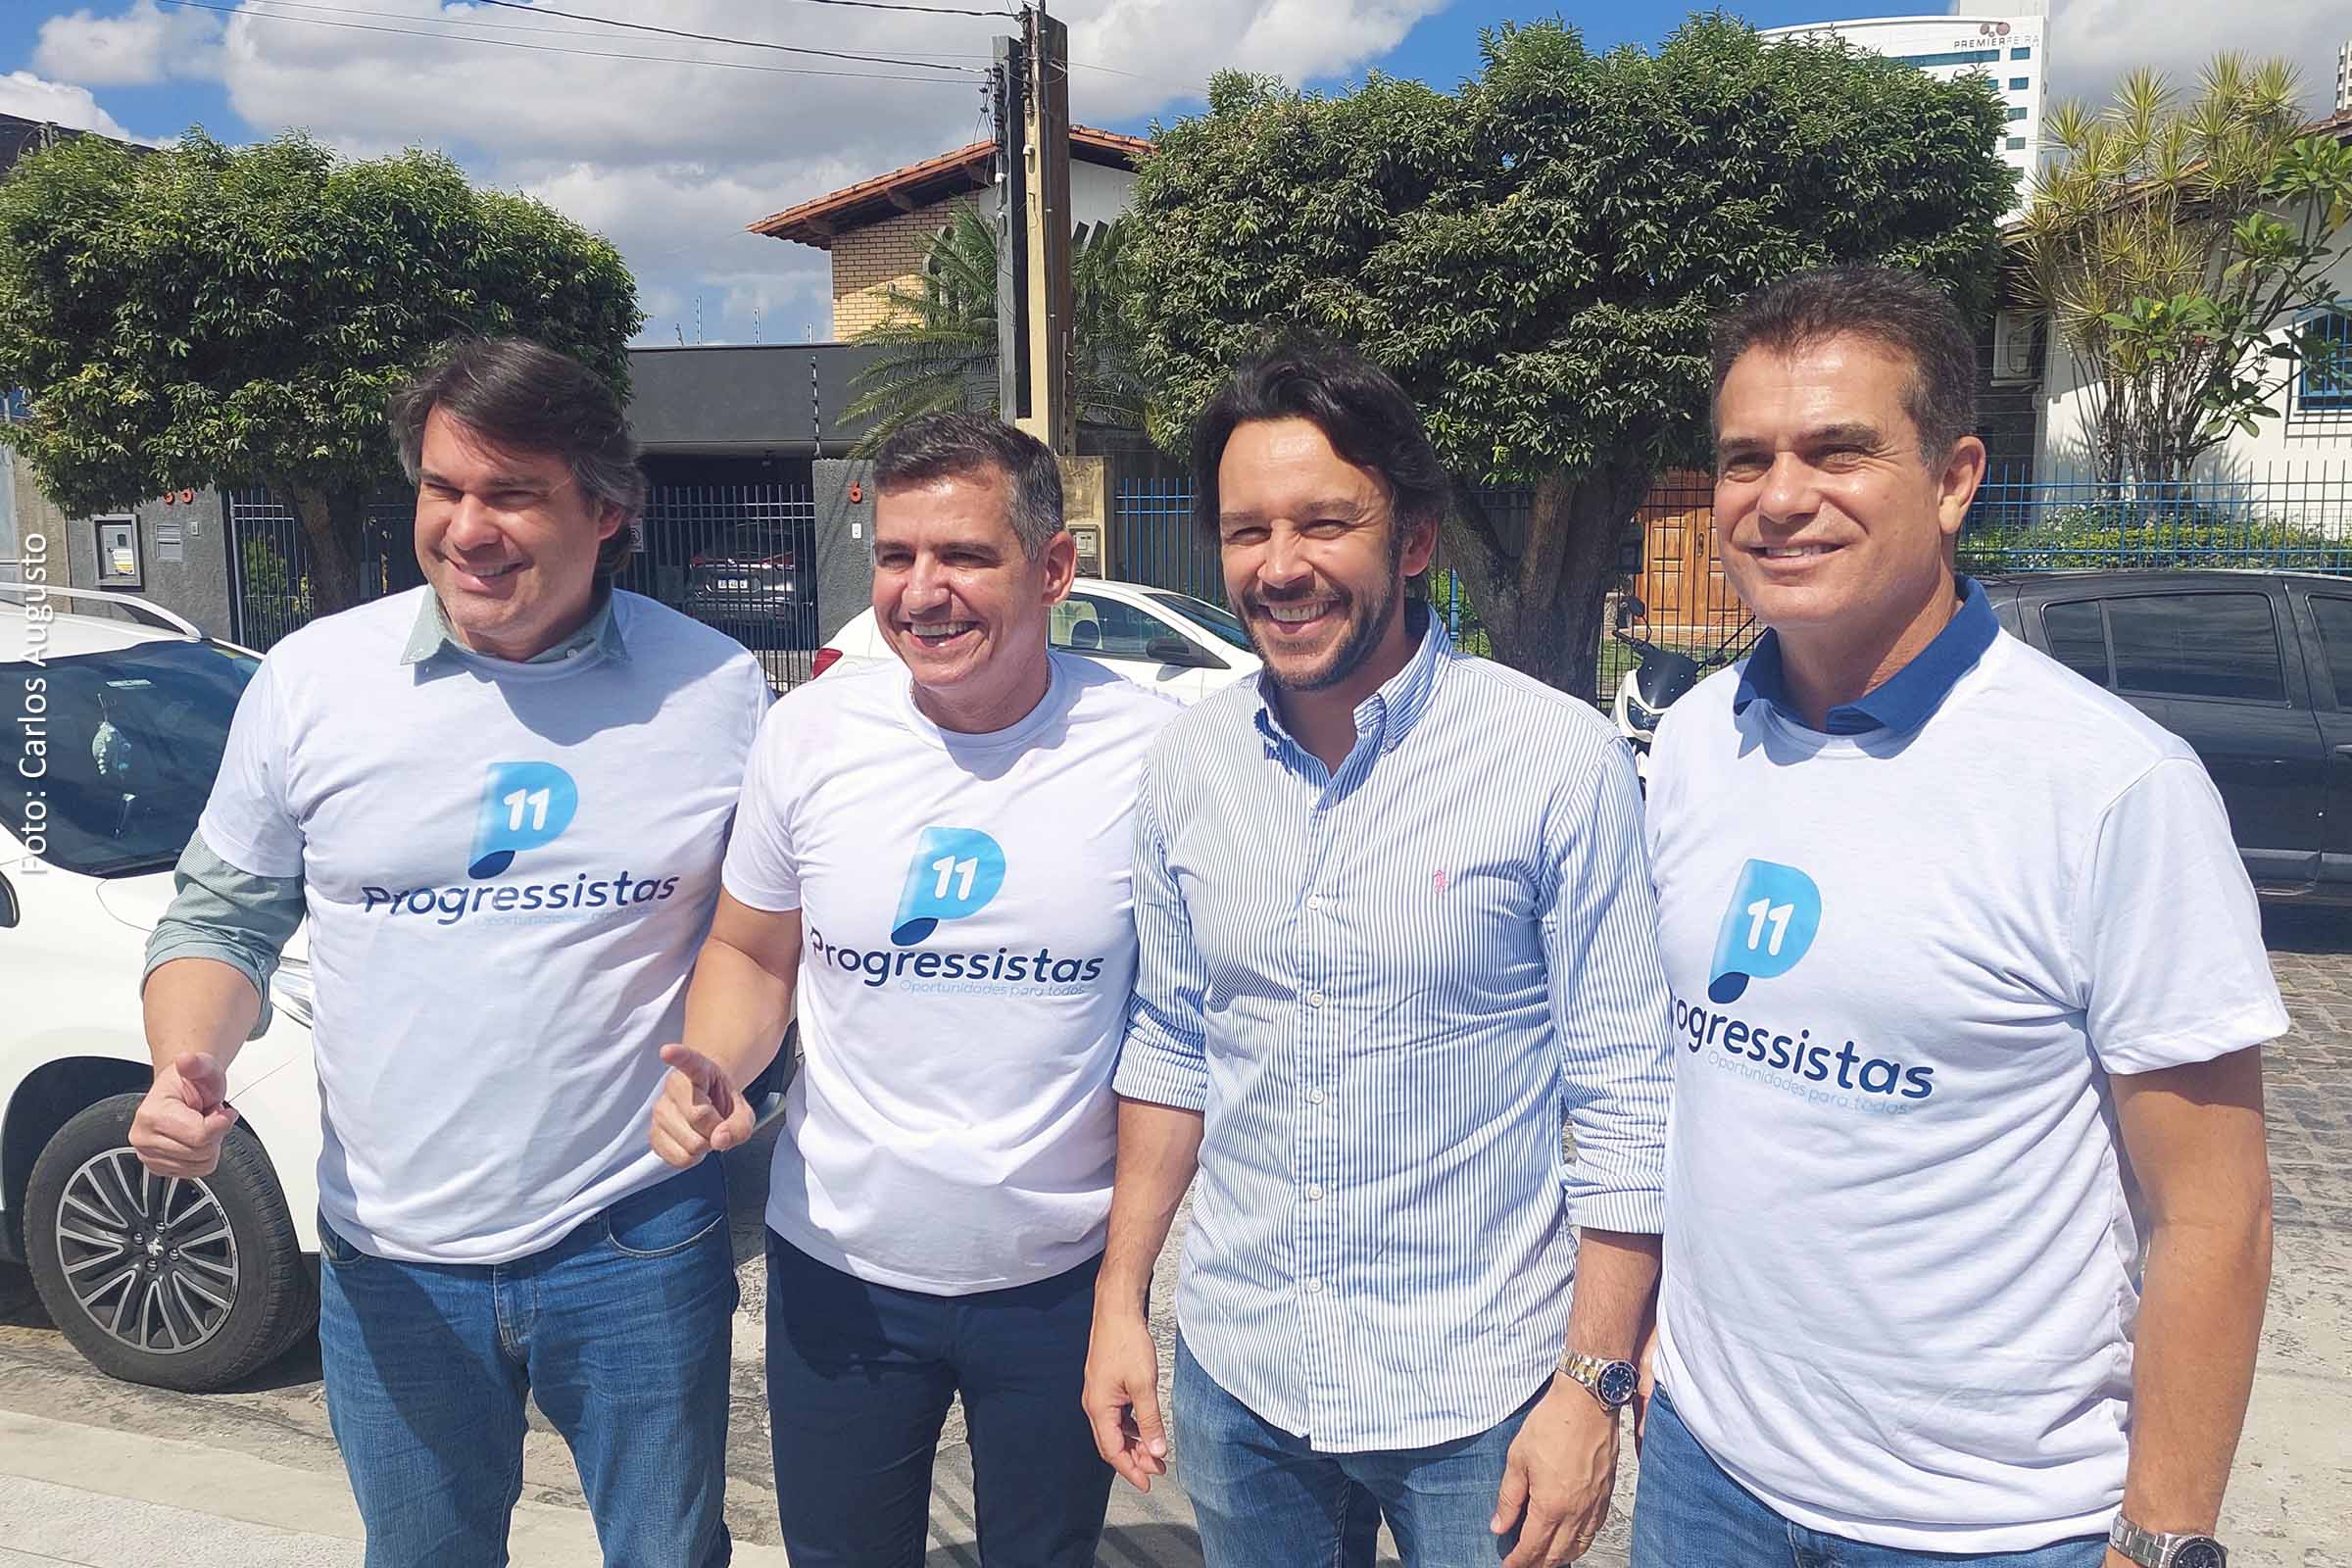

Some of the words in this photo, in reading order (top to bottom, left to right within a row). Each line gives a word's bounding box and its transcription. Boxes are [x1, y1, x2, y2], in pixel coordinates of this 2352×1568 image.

[848, 480, 862, 503] 6
[503, 788, 550, 831] 11
[361, 870, 680, 925] Progressistas
[932, 855, 978, 901] 11
[1747, 898, 1794, 956] 11
[809, 926, 1104, 988] Progressistas
[901, 981, 1006, 997] Oportunidades
[1009, 986, 1044, 999] para
[1049, 983, 1085, 997] todos
[1674, 996, 1935, 1099] ogressistas
[1707, 1050, 1806, 1097] Oportunidades
[1808, 1089, 1849, 1107] para
